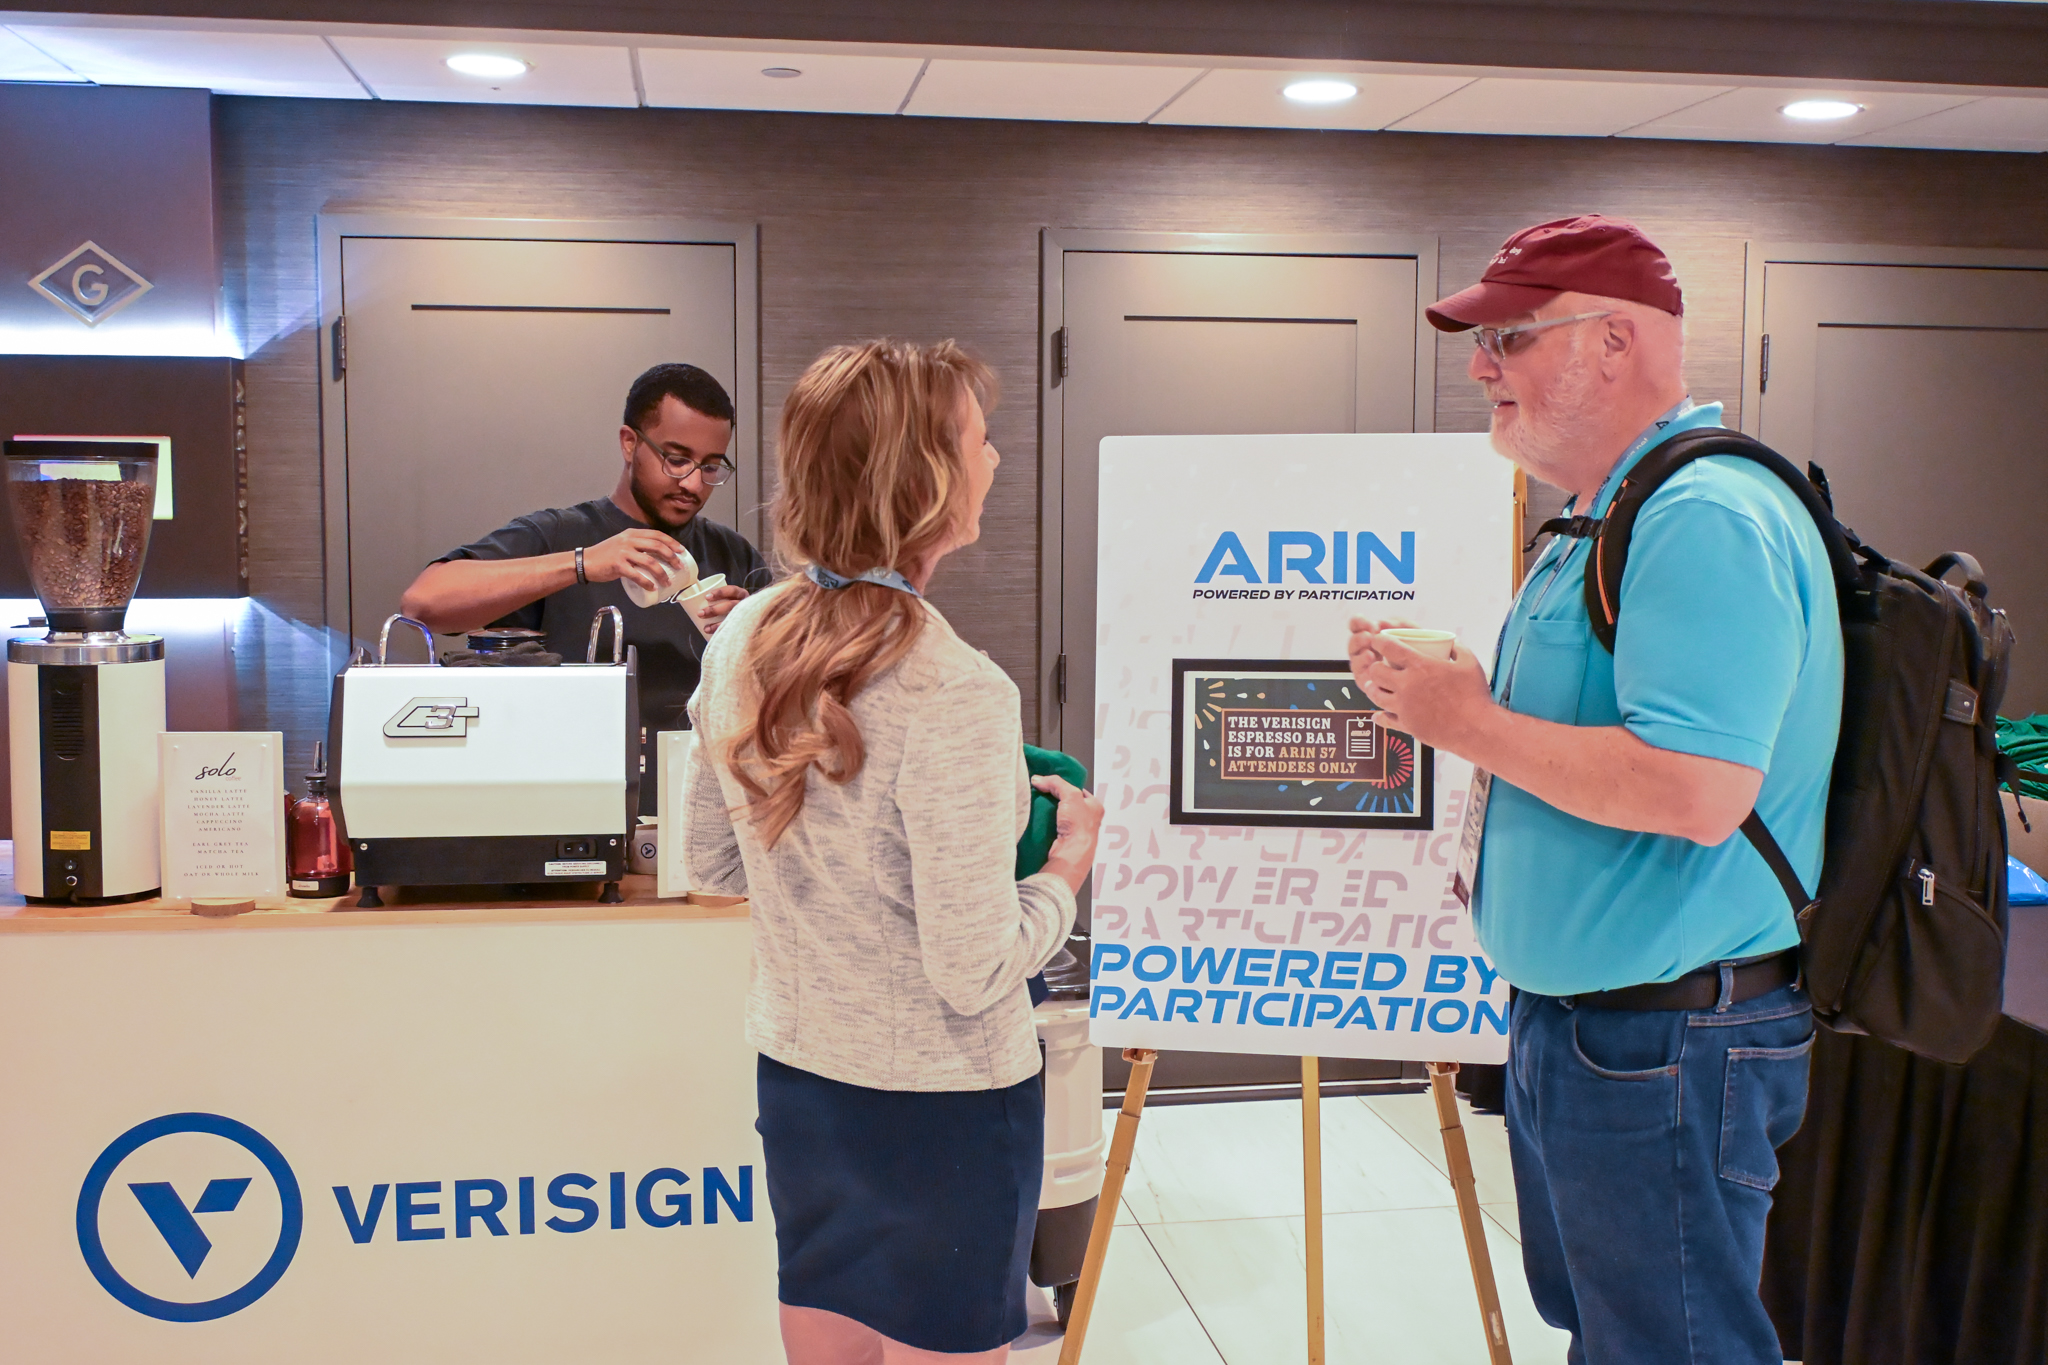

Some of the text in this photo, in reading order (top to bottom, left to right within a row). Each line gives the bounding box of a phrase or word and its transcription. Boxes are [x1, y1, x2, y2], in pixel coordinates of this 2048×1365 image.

[71, 264, 109, 306] G
[1193, 531, 1415, 584] ARIN
[1192, 589, 1415, 601] POWERED BY PARTICIPATION
[1228, 716, 1331, 729] THE VERISIGN
[1228, 731, 1336, 744] ESPRESSO BAR
[194, 751, 237, 780] solo
[1228, 746, 1337, 759] IS FOR ARIN 57
[1228, 760, 1357, 774] ATTENDEES ONLY
[1090, 943, 1500, 995] POWERED BY
[1089, 985, 1510, 1036] PARTICIPATION
[331, 1165, 755, 1245] VERISIGN
